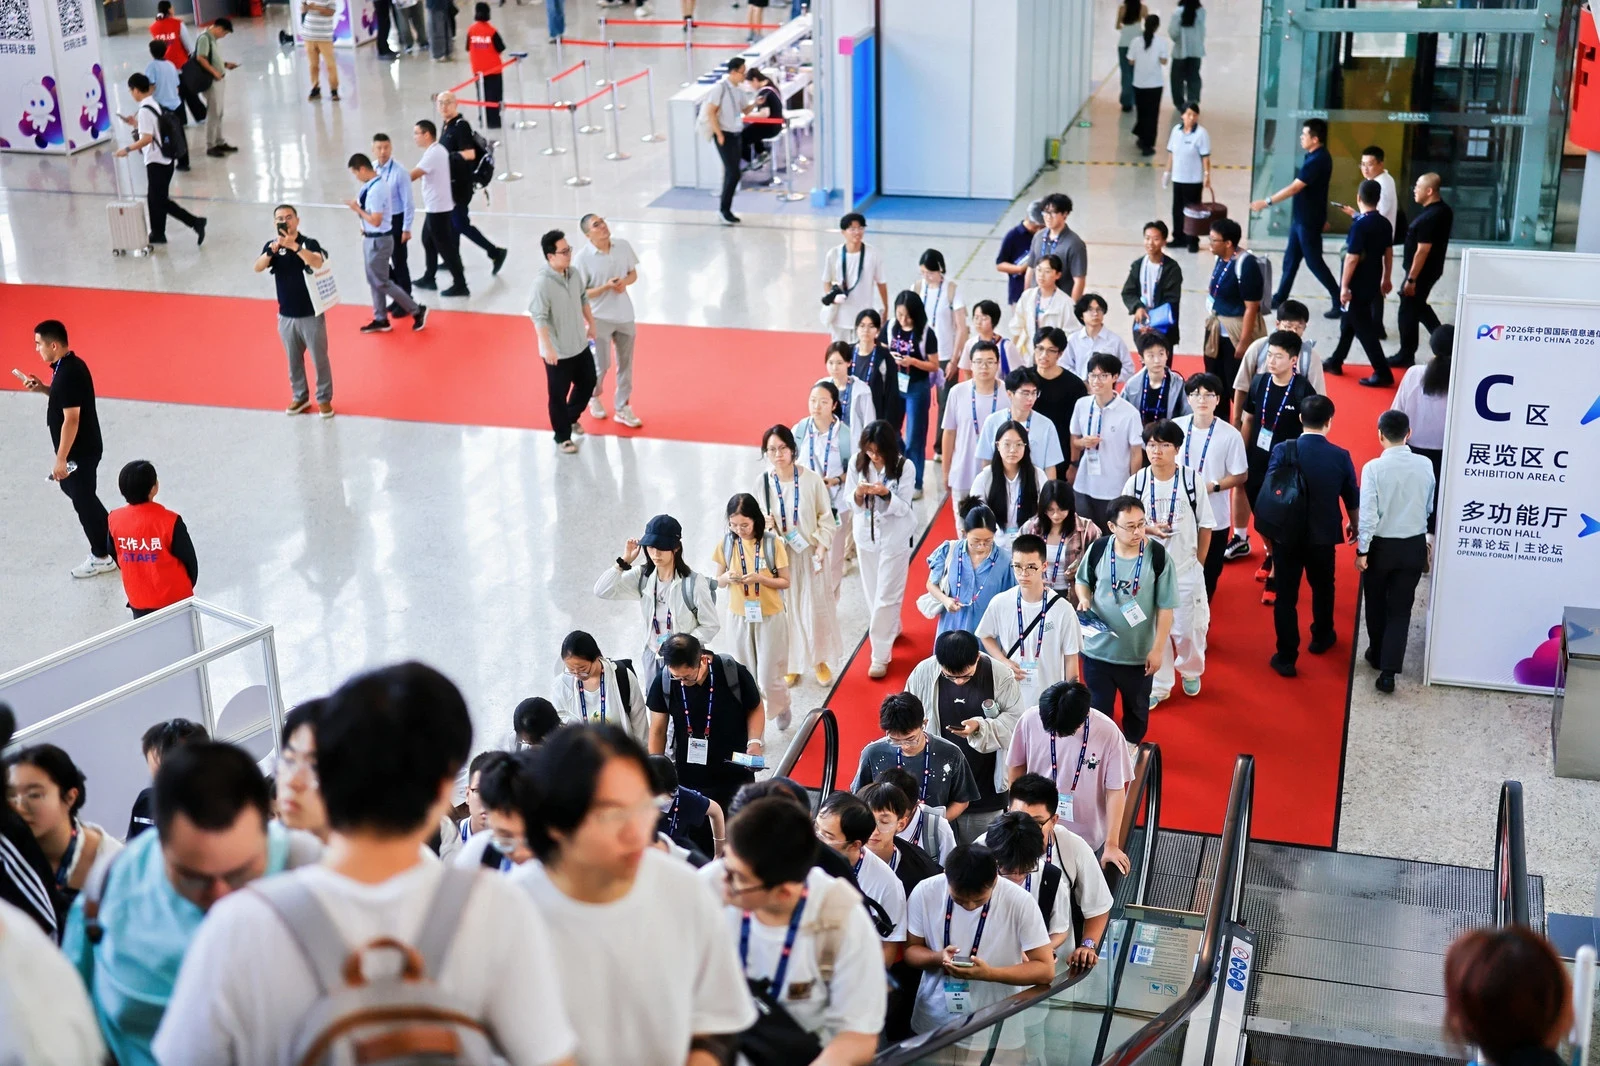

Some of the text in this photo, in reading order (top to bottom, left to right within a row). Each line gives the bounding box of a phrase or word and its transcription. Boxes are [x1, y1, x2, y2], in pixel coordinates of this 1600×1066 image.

[1475, 374, 1549, 425] C 区
[1466, 443, 1568, 468] 展览区 C
[1464, 468, 1524, 479] EXHIBITION
[1527, 473, 1556, 482] AREA
[1461, 501, 1567, 528] 多功能厅
[1459, 526, 1541, 538] FUNCTION HALL
[118, 537, 162, 550] 工作人员
[1458, 538, 1510, 552] 开幕论坛
[1524, 543, 1563, 555] 主论坛
[123, 552, 158, 562] STAFF
